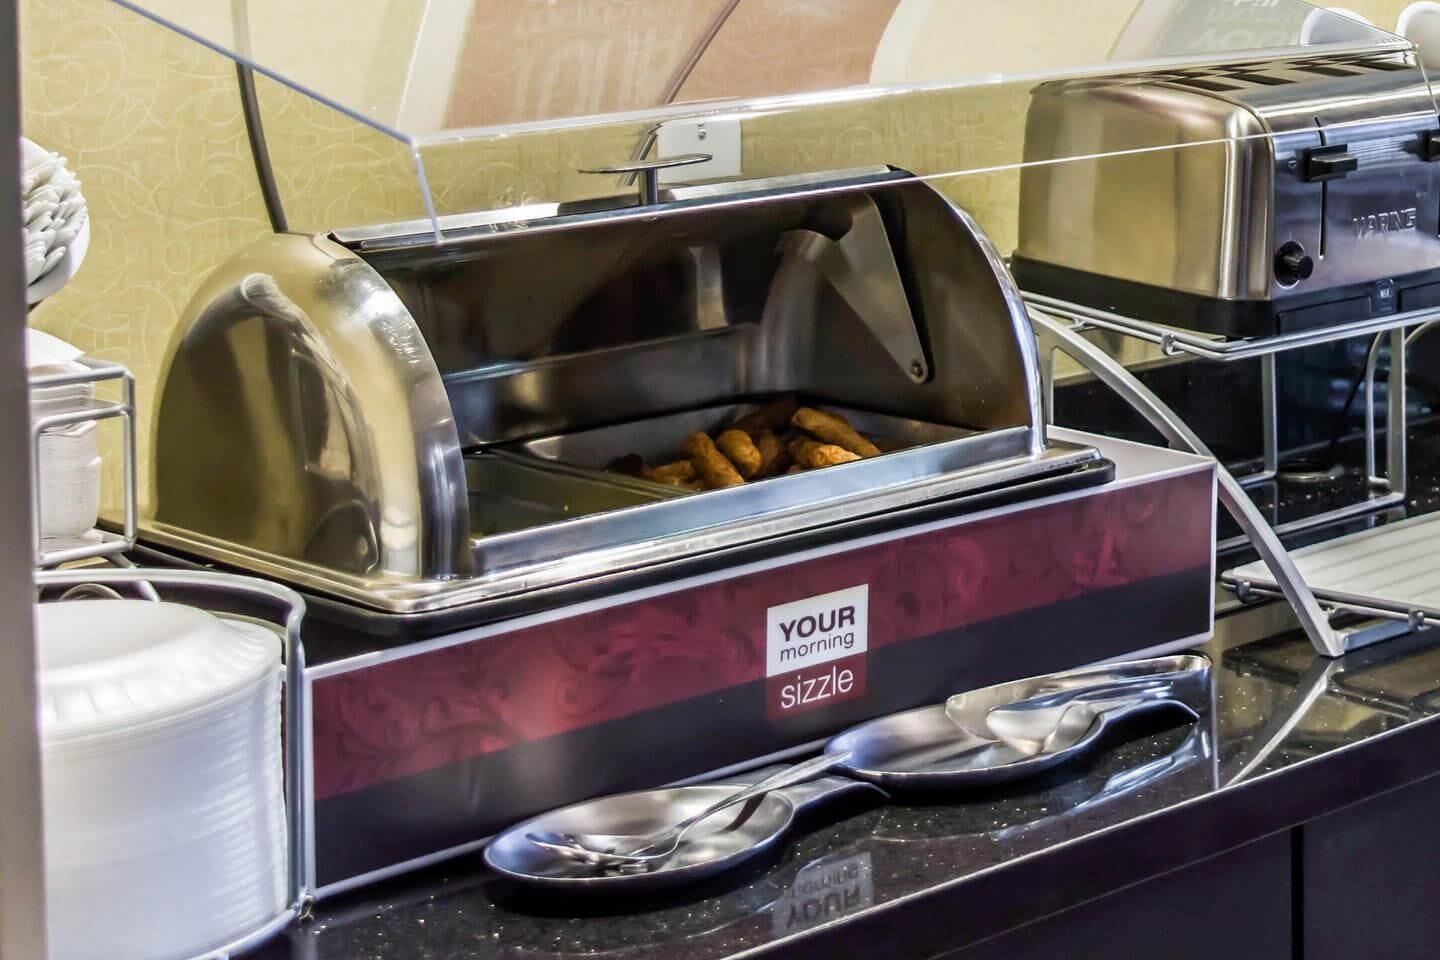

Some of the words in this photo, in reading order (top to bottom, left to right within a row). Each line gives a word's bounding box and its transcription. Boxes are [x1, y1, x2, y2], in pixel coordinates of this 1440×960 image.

[779, 605, 855, 641] YOUR
[780, 632, 854, 662] morning
[781, 665, 854, 709] sizzle
